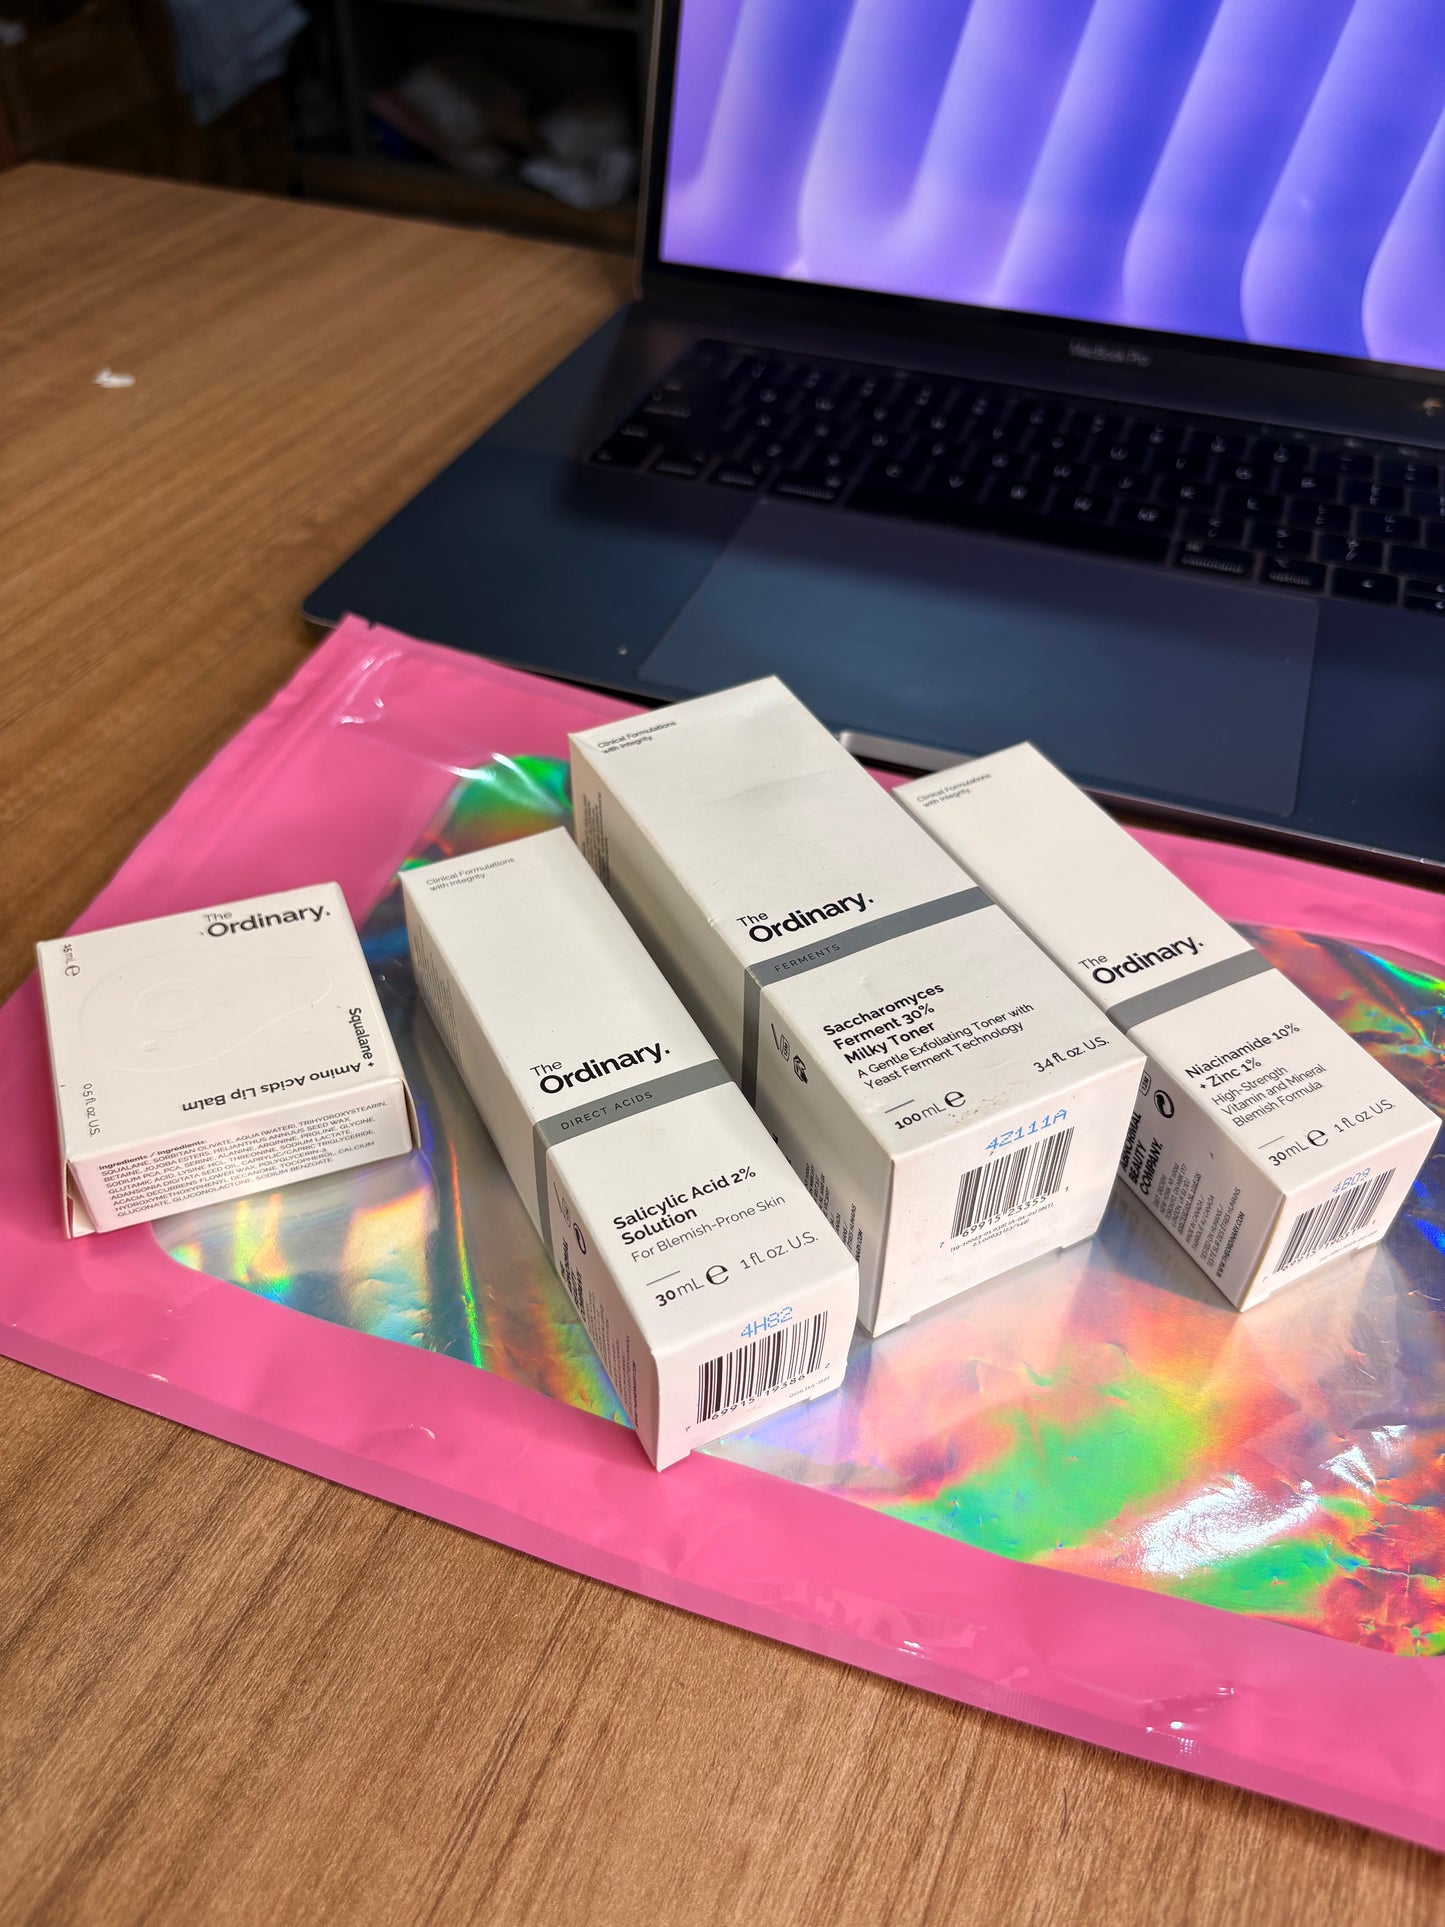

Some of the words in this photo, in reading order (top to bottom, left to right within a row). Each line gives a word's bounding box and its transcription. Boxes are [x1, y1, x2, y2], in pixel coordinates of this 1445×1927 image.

[597, 736, 628, 749] Clinical
[626, 721, 677, 740] Formulations
[602, 746, 620, 754] with
[917, 789, 946, 803] Clinical
[944, 774, 992, 793] Formulations
[922, 799, 940, 808] with
[426, 873, 459, 886] Clinical
[459, 858, 516, 877] Formulations
[430, 883, 450, 892] with
[204, 912, 233, 923] The
[207, 906, 331, 938] Ordinary.
[736, 913, 769, 927] The
[749, 893, 875, 943] Ordinary.
[774, 944, 841, 973] FERMENTS
[1078, 955, 1108, 970] The
[1092, 937, 1204, 985] Ordinary.
[823, 985, 945, 1036] Saccharomyces
[833, 1018, 903, 1051] Ferment
[901, 1003, 935, 1025] 30%
[349, 1007, 374, 1060] Squalane
[844, 1042, 889, 1065] Milky
[886, 1022, 936, 1046] Toner
[858, 1069, 869, 1079] A
[868, 1053, 910, 1073] Gentle
[909, 1027, 974, 1057] Exfoliating
[970, 1014, 1008, 1031] Toner
[1008, 1004, 1035, 1018] with
[1184, 1037, 1272, 1079] Niacinamide
[1272, 1023, 1301, 1041] 10%
[309, 1062, 361, 1081] Amino
[530, 1061, 563, 1077] The
[540, 1043, 671, 1095] Ordinary.
[864, 1070, 903, 1090] Yeast
[901, 1048, 955, 1076] Ferment
[952, 1022, 1024, 1053] Technology
[1033, 1058, 1055, 1073] 3.4
[1066, 1047, 1086, 1058] oz.
[1082, 1037, 1110, 1051] U.S.
[1206, 1069, 1241, 1088] Zinc
[1241, 1057, 1262, 1073] 1%
[230, 1088, 257, 1101] Lip
[260, 1075, 306, 1094] Acids
[1211, 1067, 1289, 1106] High-Strength
[1220, 1092, 1267, 1116] Vitamin
[1265, 1080, 1289, 1097] and
[1285, 1063, 1327, 1087] Mineral
[182, 1095, 227, 1112] Balm
[560, 1107, 607, 1131] DIRECT
[615, 1091, 653, 1111] ACIDS
[1232, 1102, 1280, 1128] Blemish
[1277, 1082, 1324, 1106] Formula
[1334, 1124, 1345, 1133] 1
[1369, 1099, 1396, 1115] U.S.
[144, 1160, 178, 1173] JOJOBA
[213, 1137, 268, 1154] HELIANTHUS
[269, 1128, 306, 1141] ANNUUS
[307, 1122, 329, 1132] SEED
[153, 1148, 196, 1164] SORBITAN
[236, 1132, 261, 1143] AQUA
[338, 1141, 376, 1154] CALCIUM
[1120, 1111, 1142, 1173] ABNORMAL
[99, 1155, 149, 1171] Ingredients
[108, 1179, 153, 1195] GLUTAMIC
[280, 1138, 314, 1151] SODIUM
[1128, 1140, 1147, 1186] BEAUTY
[1139, 1137, 1164, 1196] COMPANY.
[106, 1175, 142, 1189] SODIUM
[111, 1183, 163, 1201] ADANSONIA
[163, 1173, 201, 1187] DIGITATA
[201, 1167, 224, 1177] SEED
[113, 1194, 146, 1207] ACACIA
[199, 1170, 235, 1184] FLOWER
[613, 1194, 689, 1230] Salicylic
[692, 1175, 731, 1200] Acid
[731, 1166, 757, 1184] 2%
[621, 1209, 698, 1246] Solution
[631, 1247, 655, 1263] For
[656, 1208, 756, 1252] Blemish-Prone
[756, 1196, 786, 1212] Skin
[961, 1214, 1002, 1238] 69915
[1008, 1192, 1048, 1217] 23355
[740, 1259, 751, 1270] 1
[787, 1231, 819, 1250] U.S.
[1216, 1211, 1246, 1279] WWW.THEORDINARY.COM
[741, 1306, 793, 1338] 4H82
[711, 1396, 756, 1421] 69915
[764, 1374, 806, 1396] 19386
